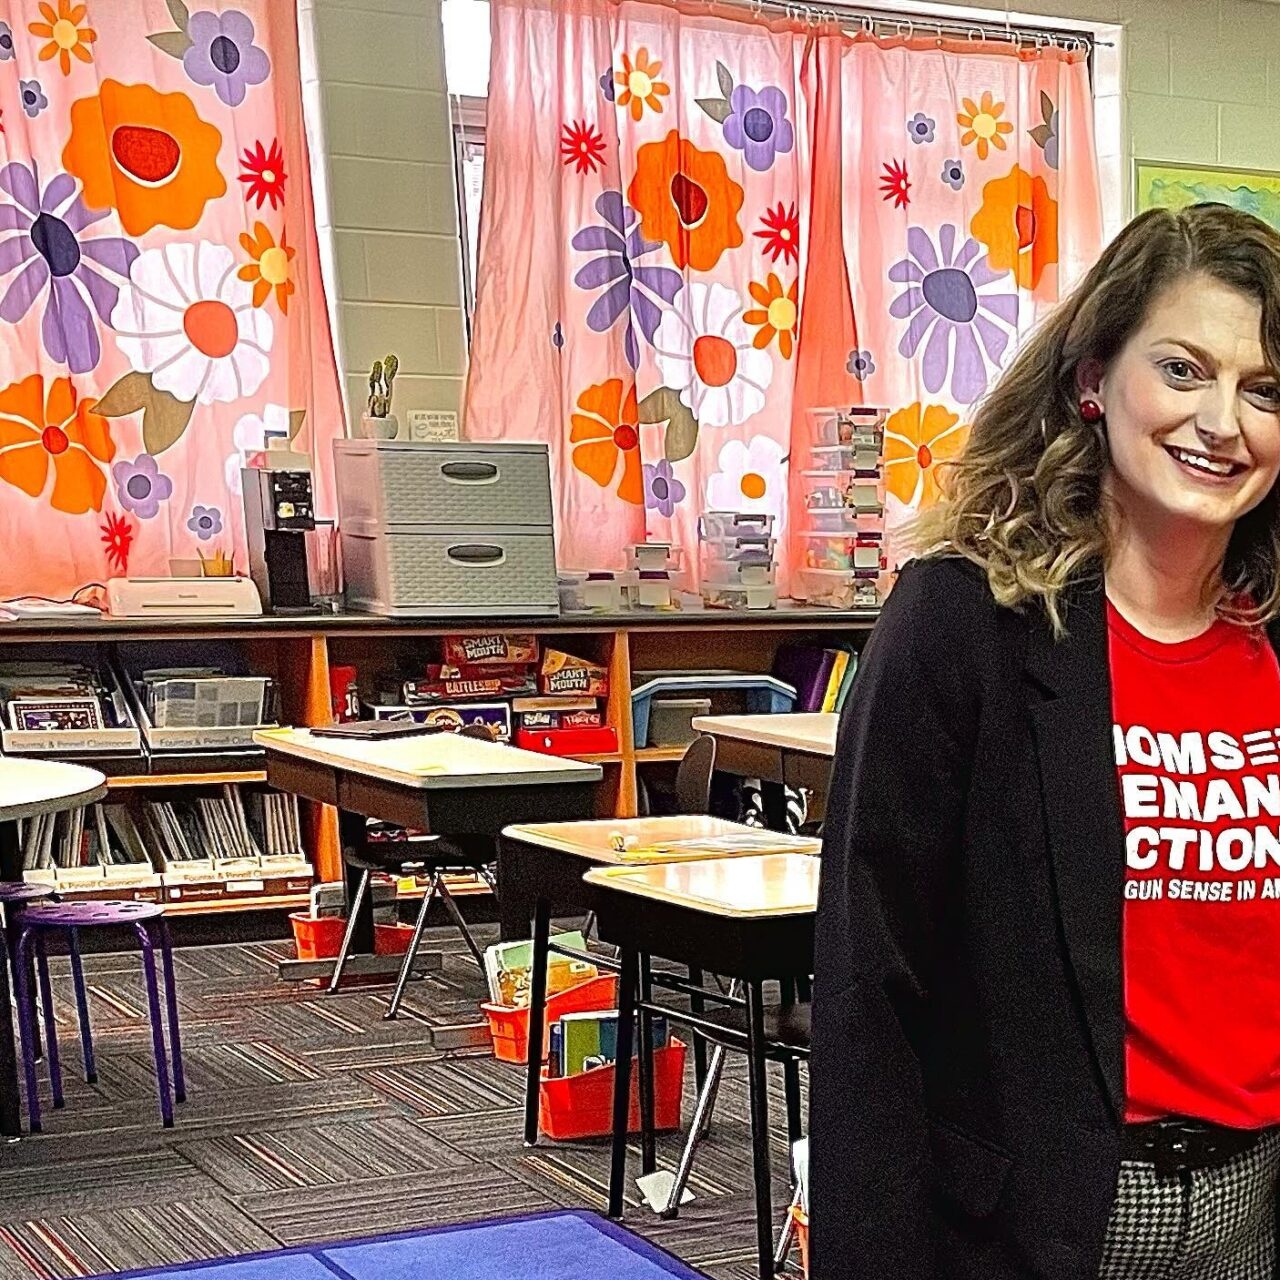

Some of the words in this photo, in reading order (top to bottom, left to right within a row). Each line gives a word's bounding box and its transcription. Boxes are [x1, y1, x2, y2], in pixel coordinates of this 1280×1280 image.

[464, 637, 503, 648] SMART
[466, 646, 505, 658] MOUTH
[445, 679, 502, 694] BATTLESHIP
[550, 678, 588, 691] MOUTH
[1124, 879, 1163, 901] GUN
[1168, 880, 1233, 902] SENSE
[1237, 880, 1256, 900] IN
